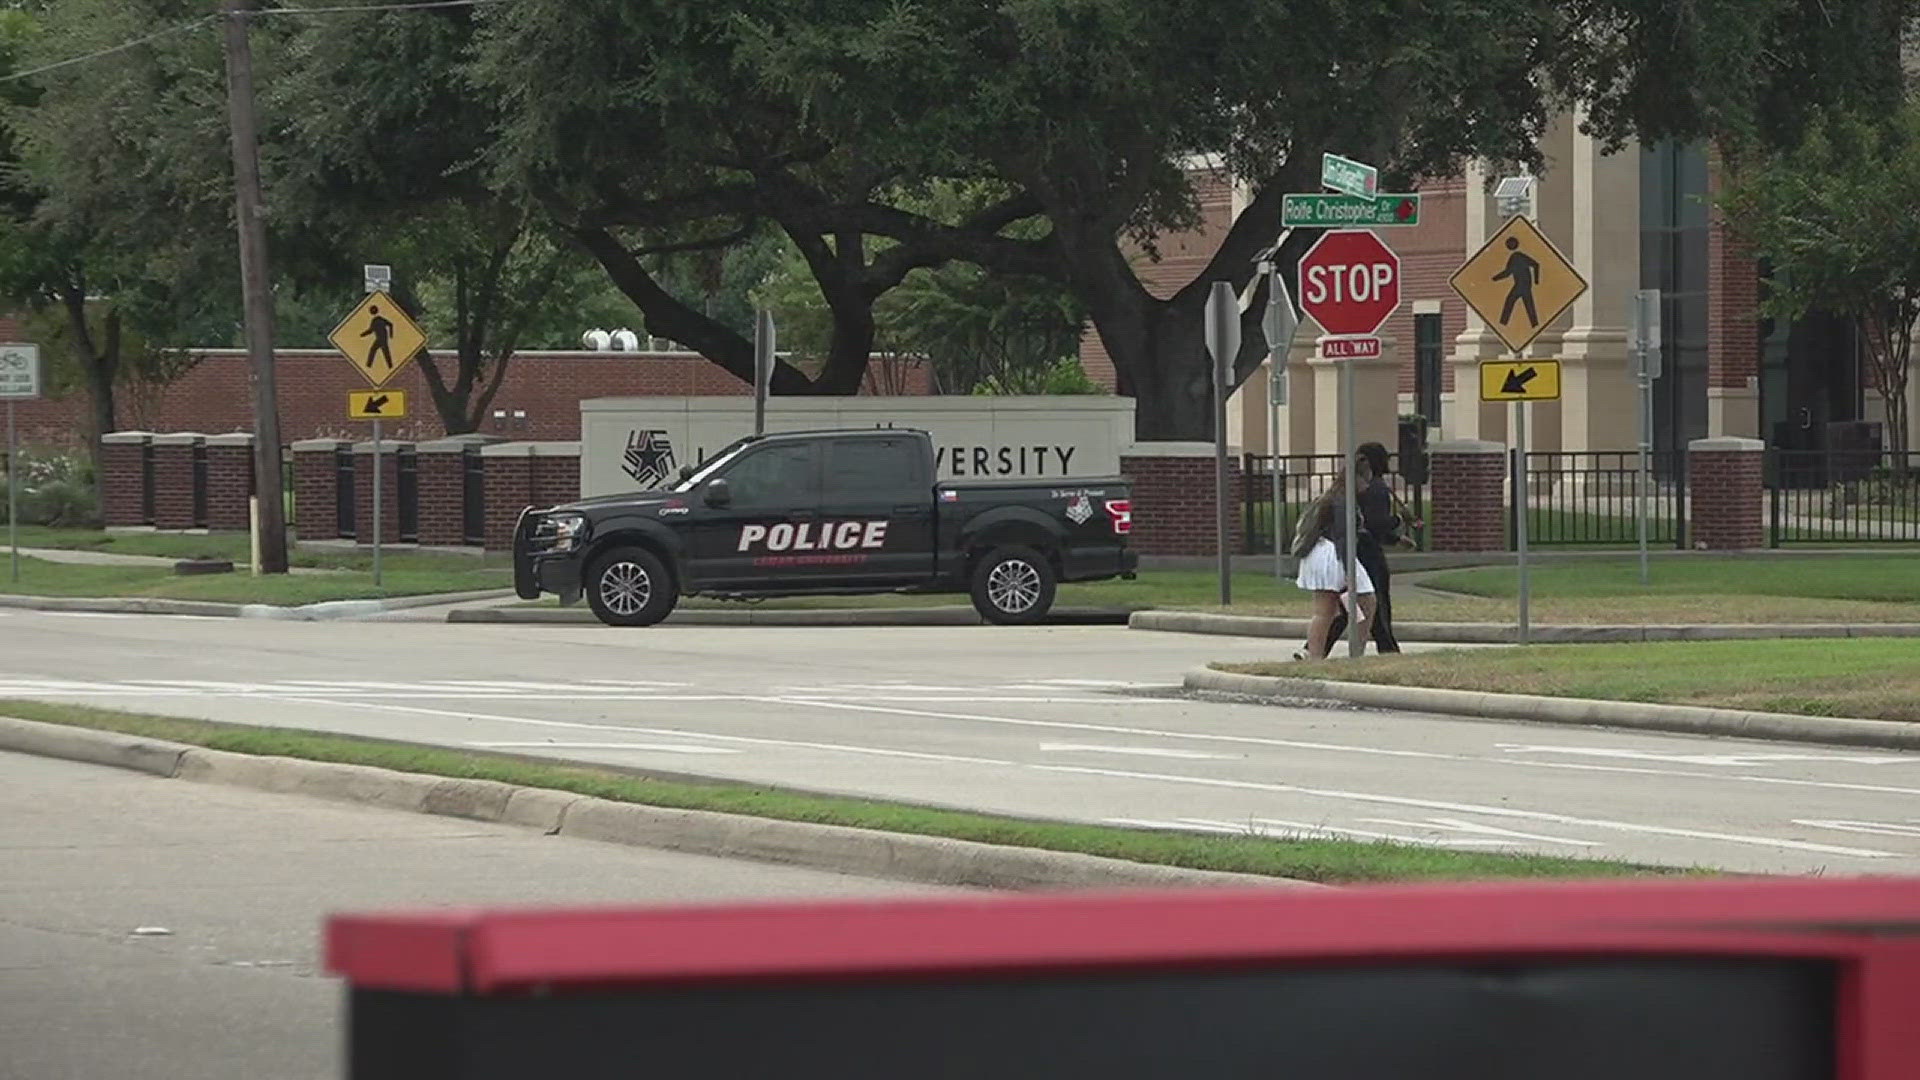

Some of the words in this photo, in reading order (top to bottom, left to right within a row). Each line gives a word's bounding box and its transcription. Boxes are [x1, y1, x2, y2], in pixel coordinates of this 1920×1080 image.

[1285, 199, 1313, 220] Rolfe
[1316, 199, 1377, 224] Christopher
[1306, 263, 1393, 303] STOP
[1325, 343, 1348, 356] ALL
[1352, 341, 1376, 354] WAY
[737, 520, 889, 551] POLICE
